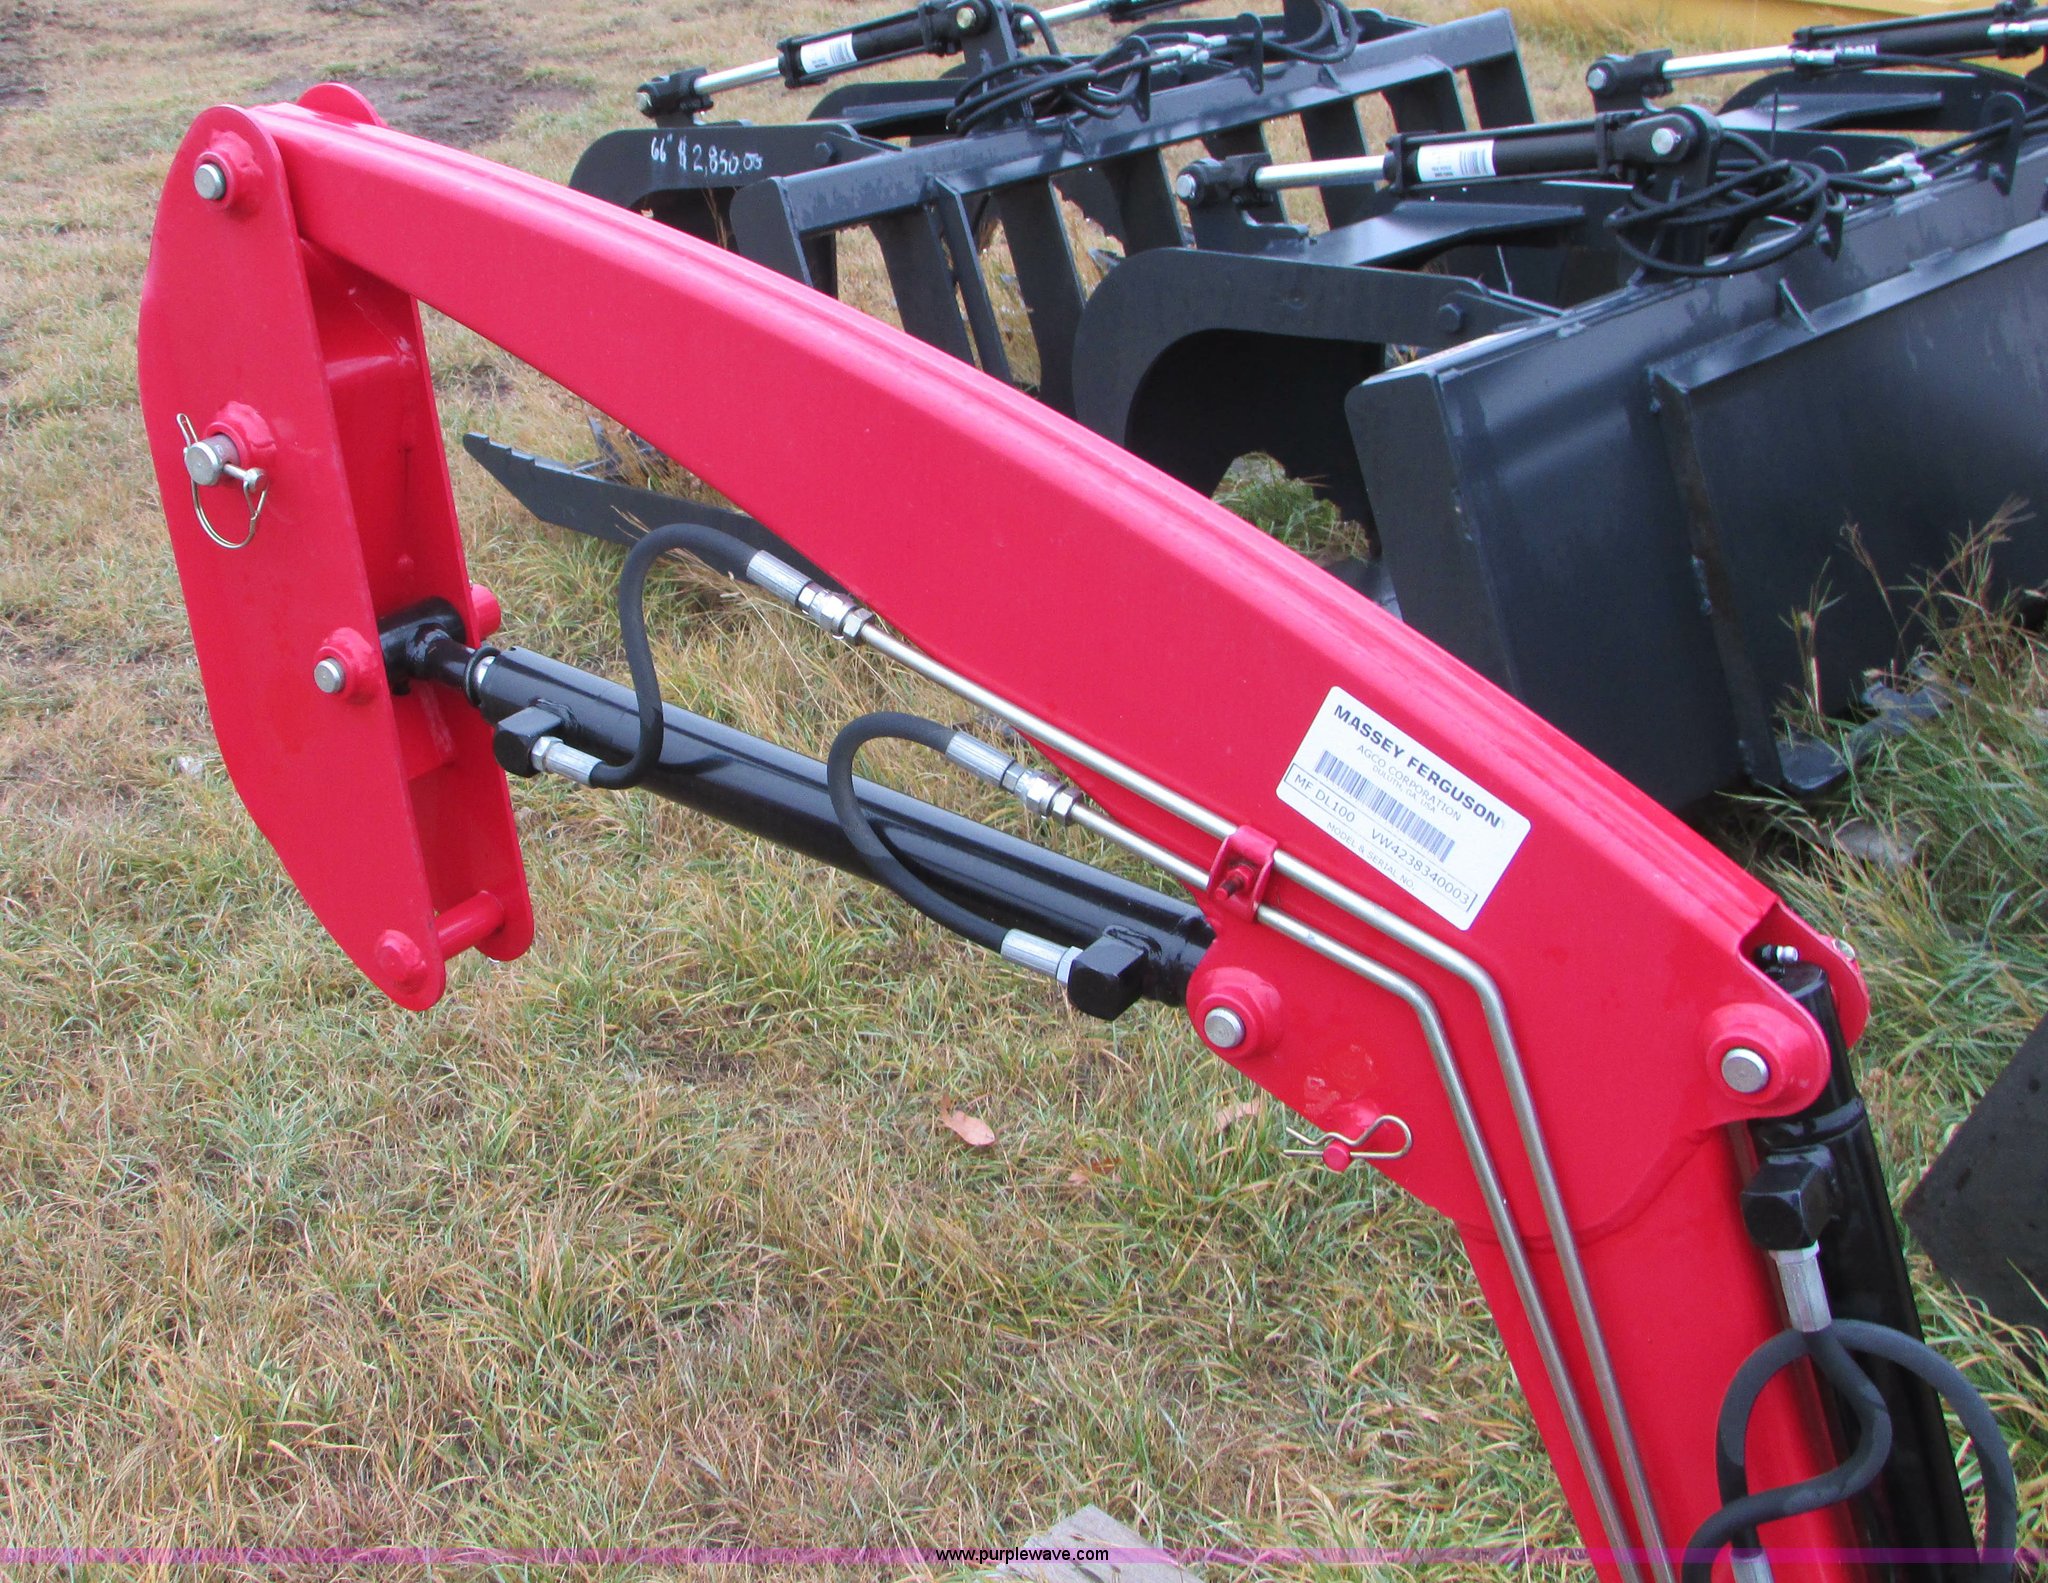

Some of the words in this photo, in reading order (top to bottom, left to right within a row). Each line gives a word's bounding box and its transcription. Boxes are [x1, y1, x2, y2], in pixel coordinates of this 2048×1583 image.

[1333, 704, 1405, 759] MASSEY
[1407, 757, 1501, 828] FERGUSON
[1356, 744, 1386, 769] AGCO
[1388, 766, 1462, 822] CORPORATION
[1293, 773, 1313, 791] MF
[1315, 789, 1355, 823] DL100
[1371, 828, 1470, 906] VW4238340003
[1420, 798, 1437, 814] USA
[1326, 822, 1357, 851] MODEL
[1358, 845, 1365, 855] &
[1366, 850, 1398, 880] SERIAL
[1399, 873, 1415, 891] NO.
